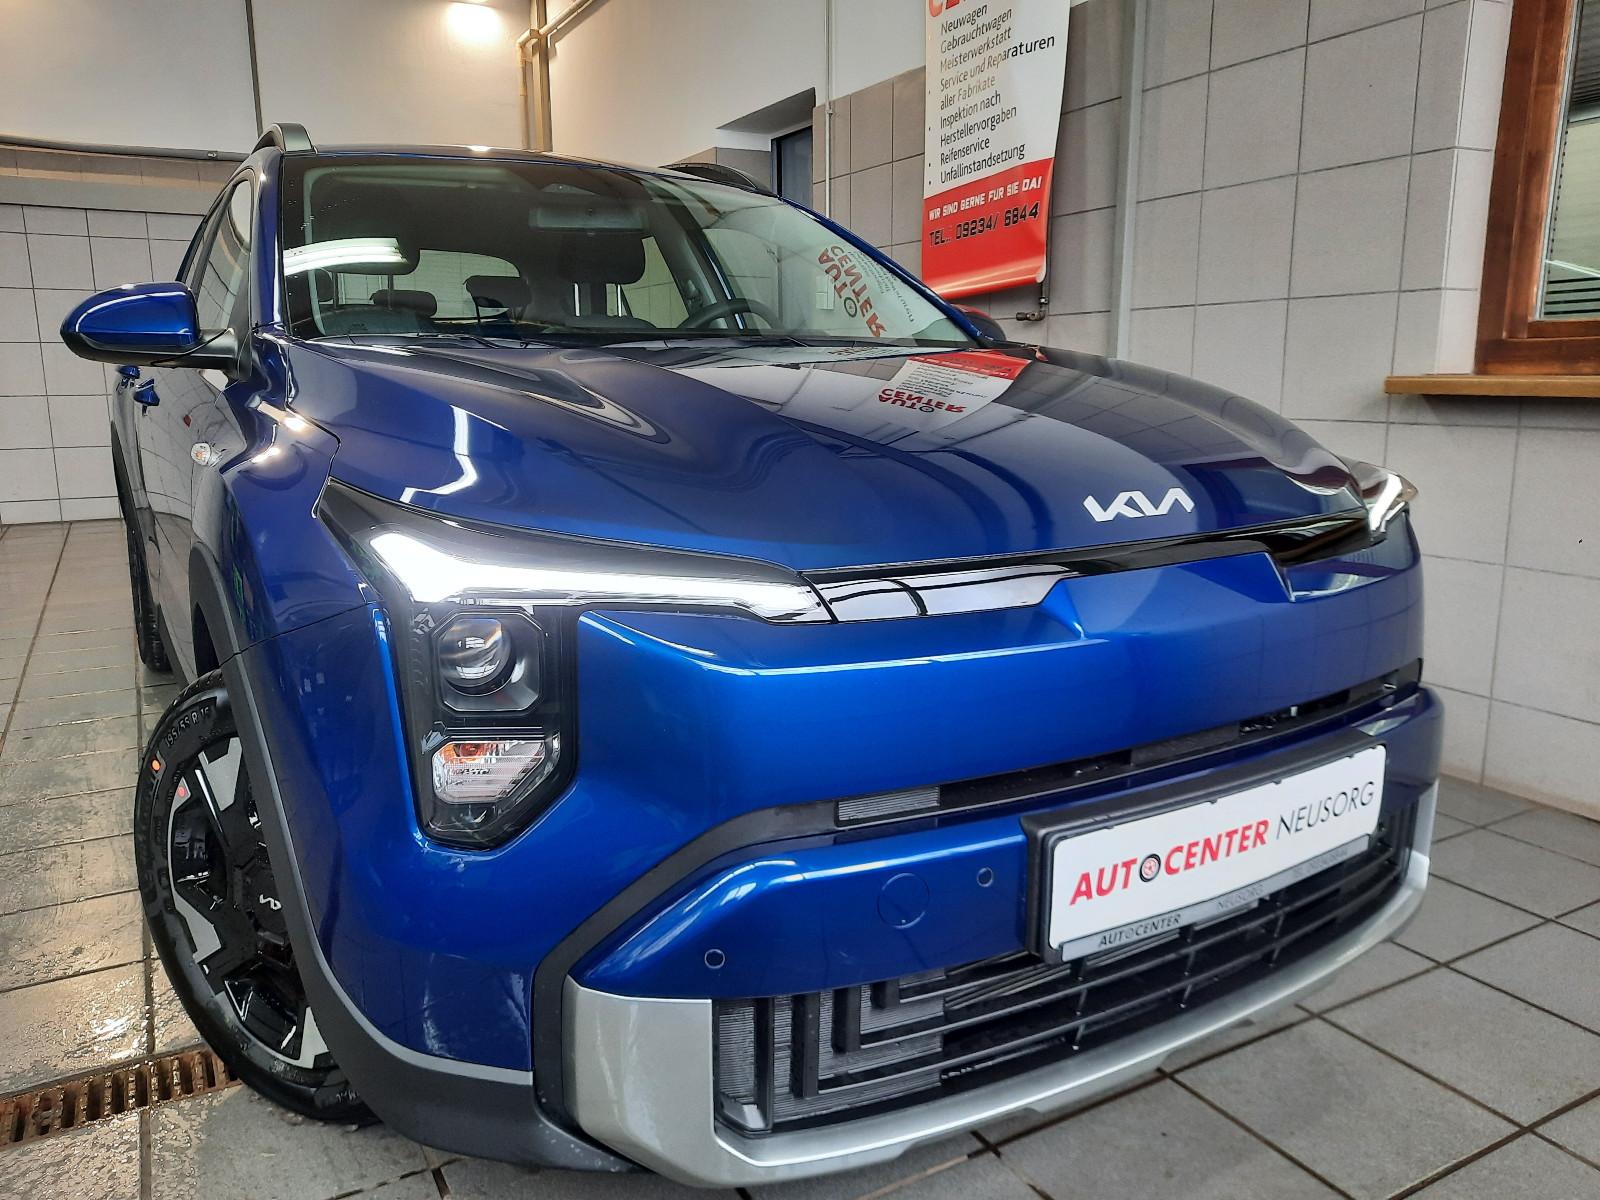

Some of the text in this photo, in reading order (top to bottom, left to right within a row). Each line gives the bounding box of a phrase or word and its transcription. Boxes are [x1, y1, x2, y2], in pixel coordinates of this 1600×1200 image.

[940, 4, 988, 36] Neuwagen
[940, 8, 1012, 54] Gebrauchtwagen
[940, 27, 1012, 73] Meisterwerkstatt
[940, 35, 1055, 92] Service und Reparaturen
[940, 75, 996, 111] aller Fabrikate
[940, 89, 1001, 129] Inspektion nach
[940, 106, 1017, 148] Herstellervorgaben
[940, 137, 990, 167] Reifenservice
[940, 143, 1026, 184] Unfallinstandsetzung
[928, 207, 941, 221] WIR
[942, 201, 959, 217] SIND
[1006, 181, 1020, 197] SIE
[1021, 175, 1043, 192] DA!
[1004, 201, 1040, 227] 6844
[1275, 781, 1375, 841] NEUSORG
